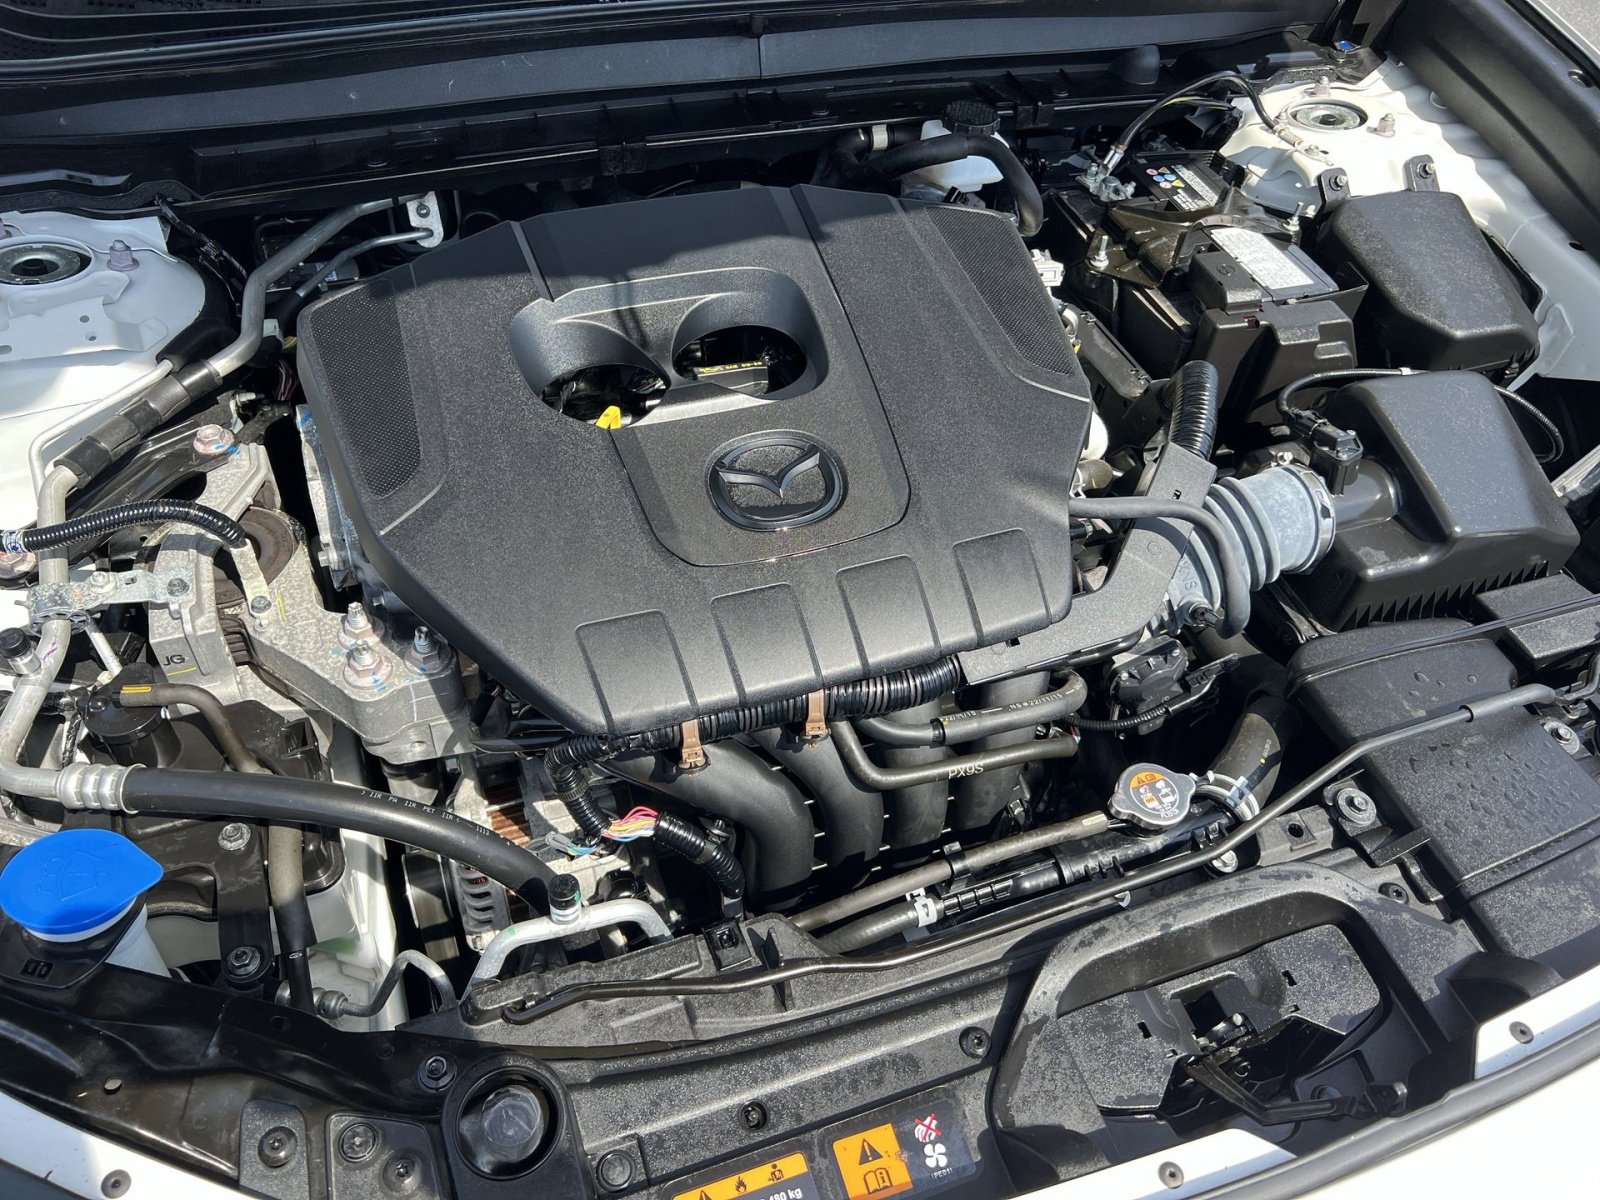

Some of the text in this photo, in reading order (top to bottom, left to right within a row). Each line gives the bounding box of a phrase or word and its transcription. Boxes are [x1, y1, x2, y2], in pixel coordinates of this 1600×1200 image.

[163, 654, 186, 667] JG
[948, 761, 984, 780] PX9S
[787, 1187, 803, 1199] kg
